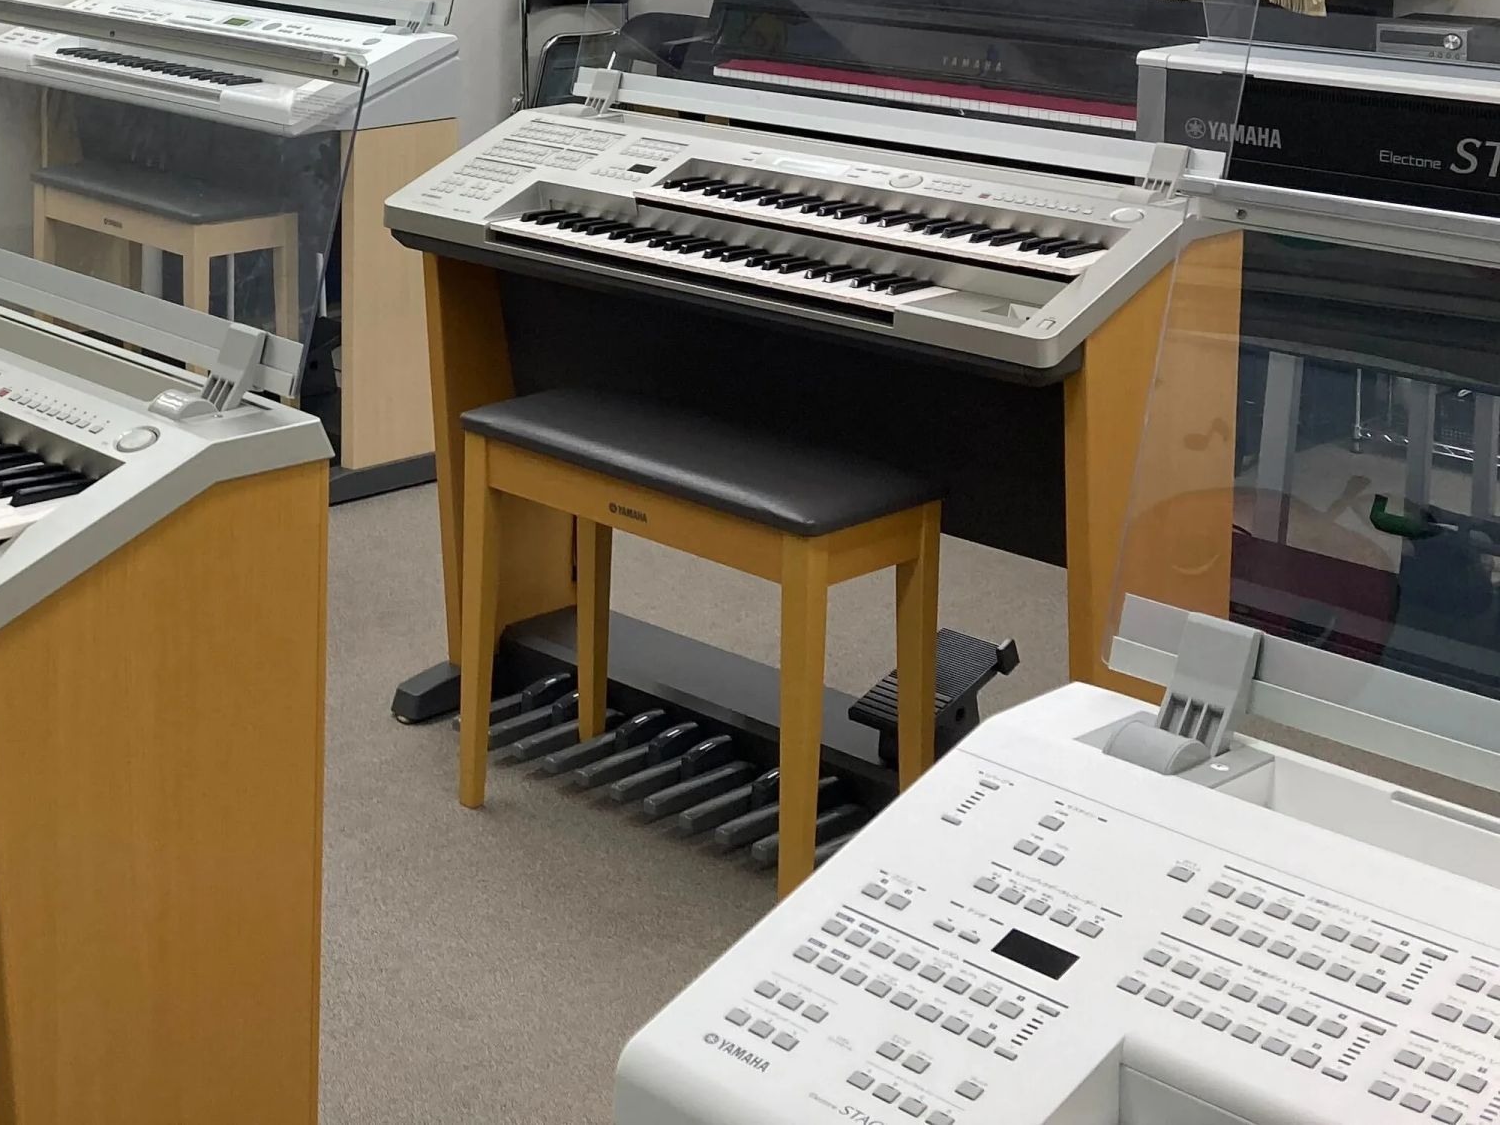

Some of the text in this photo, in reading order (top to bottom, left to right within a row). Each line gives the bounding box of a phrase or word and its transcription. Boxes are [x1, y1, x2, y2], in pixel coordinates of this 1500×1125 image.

[1208, 120, 1282, 149] YAMAHA
[1379, 149, 1442, 170] Electone
[717, 1039, 771, 1073] YAMAHA
